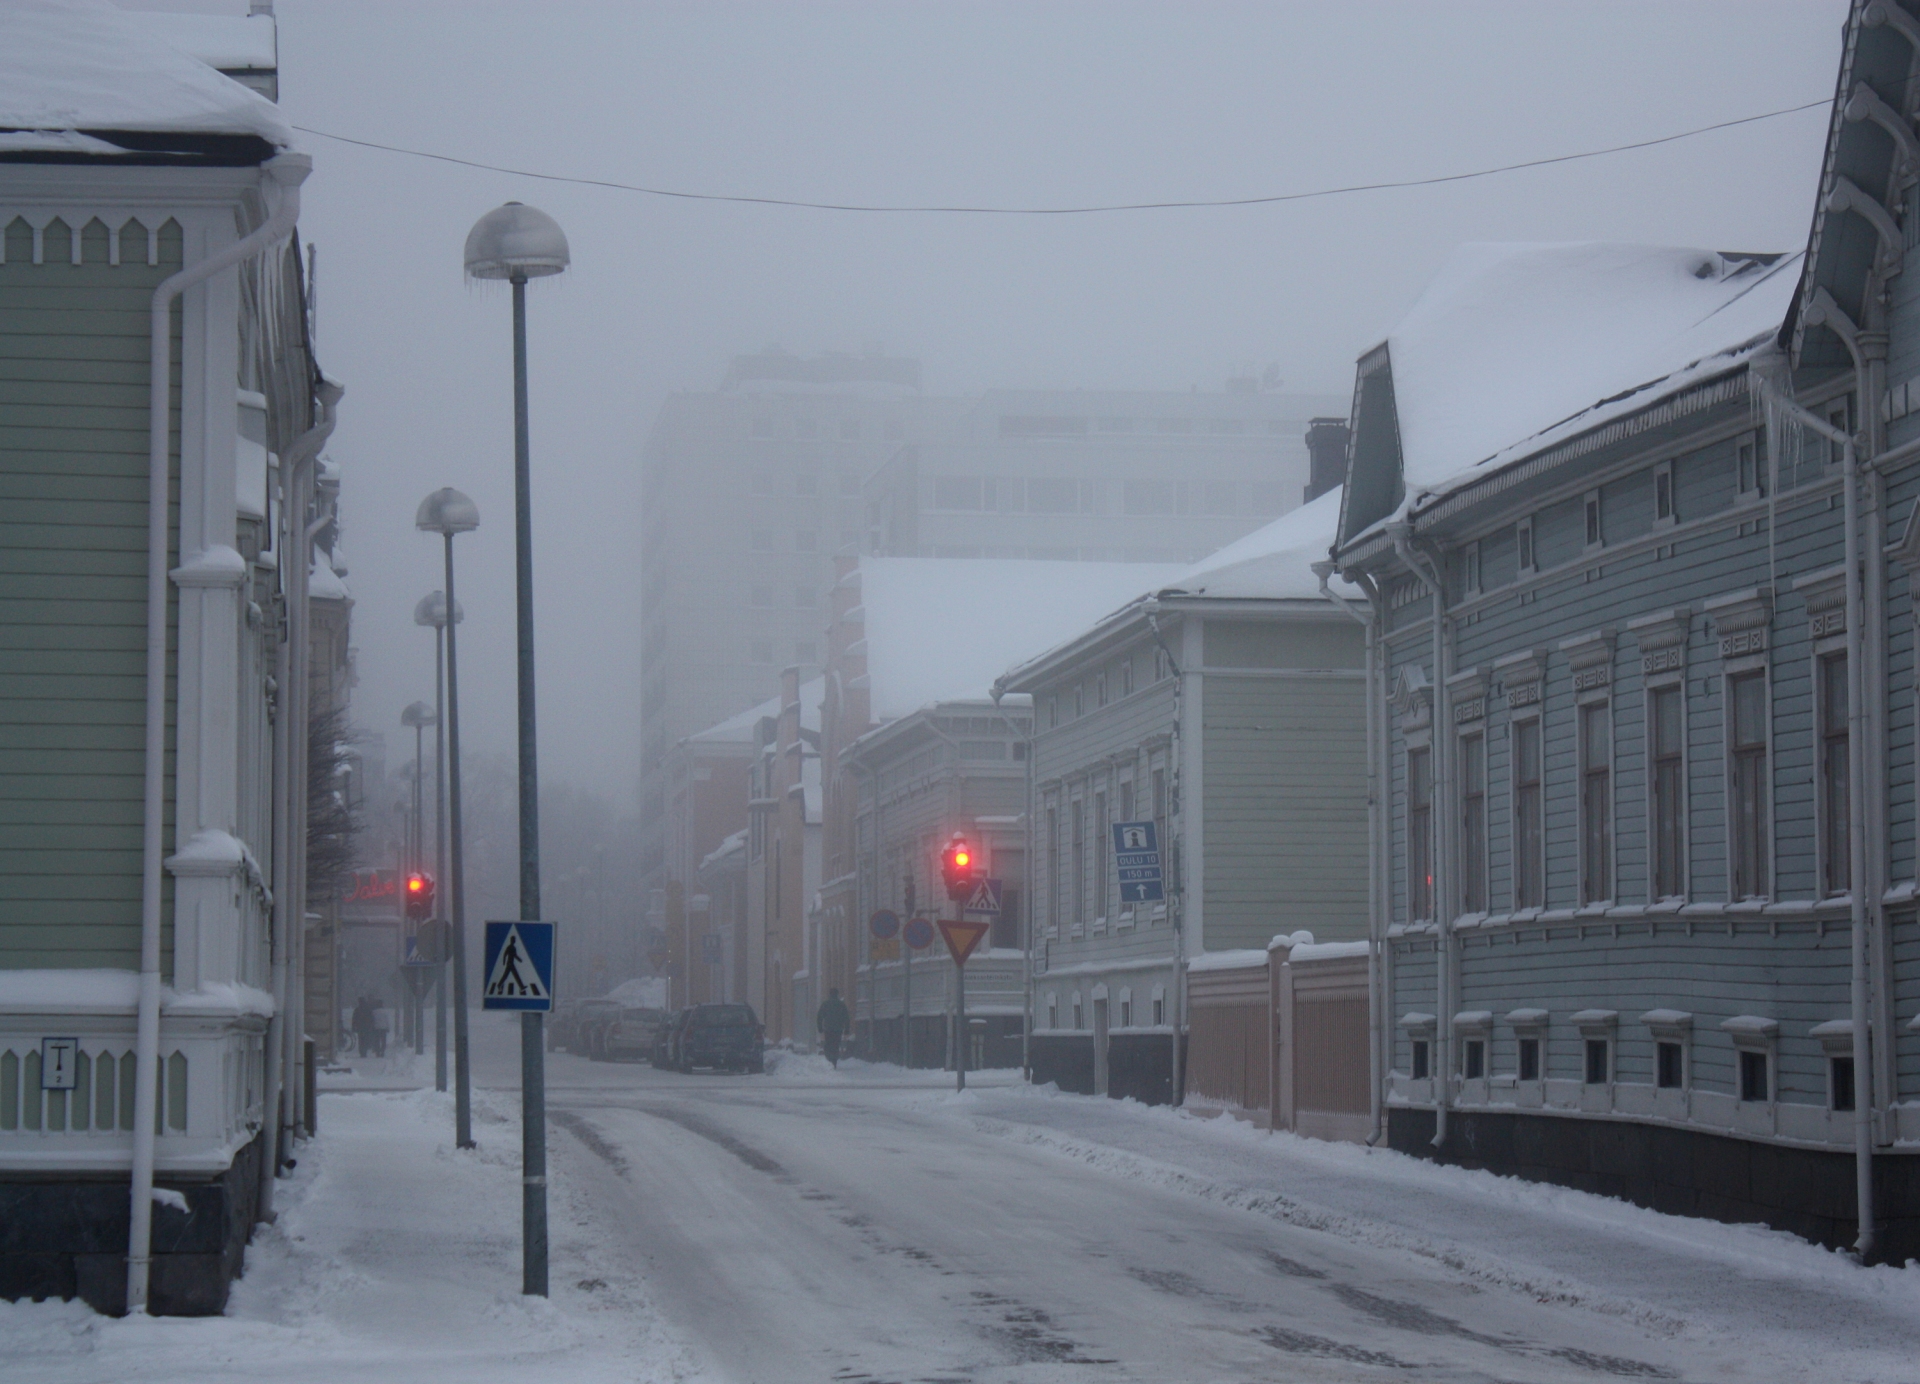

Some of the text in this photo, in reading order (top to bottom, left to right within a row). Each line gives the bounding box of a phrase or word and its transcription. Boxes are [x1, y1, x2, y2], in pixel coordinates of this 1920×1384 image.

[1120, 855, 1156, 865] OULU 10
[1127, 870, 1142, 878] 150
